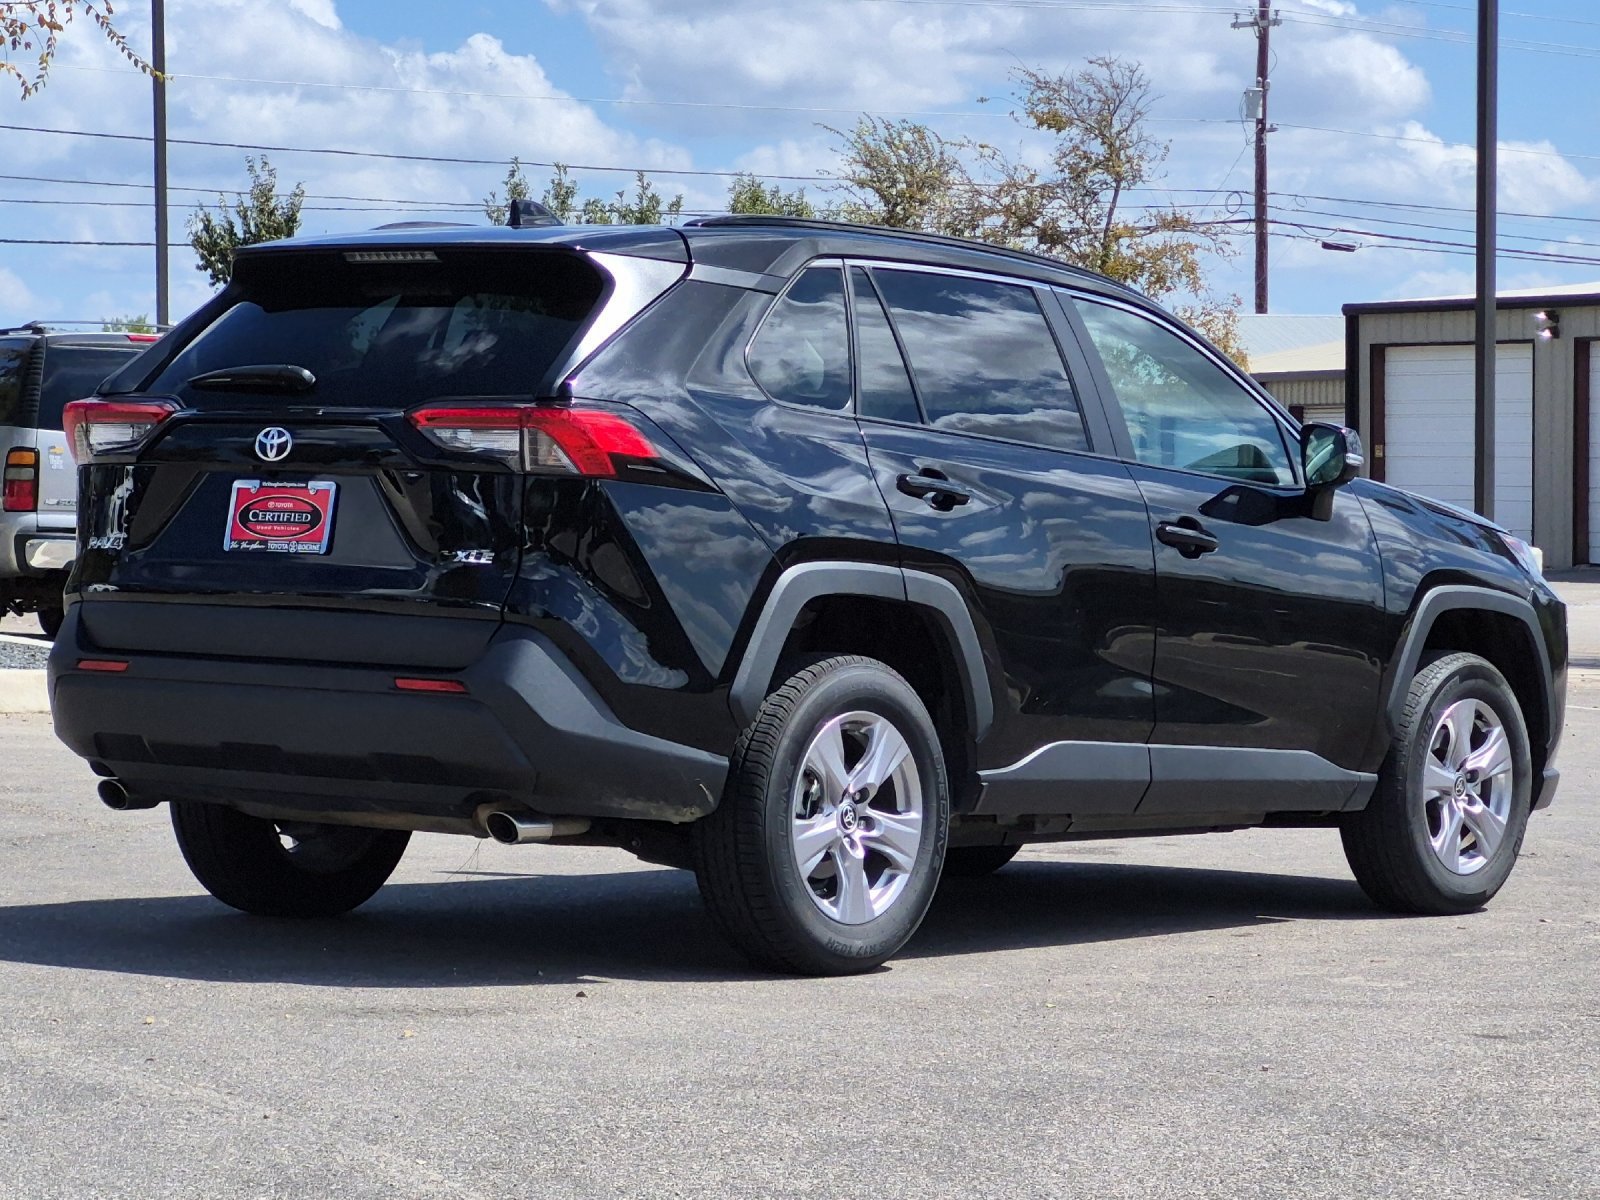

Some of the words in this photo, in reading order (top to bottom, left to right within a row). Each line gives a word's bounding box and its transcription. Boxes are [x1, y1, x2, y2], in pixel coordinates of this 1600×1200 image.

[249, 509, 311, 522] CERTIFIED
[88, 535, 124, 550] RAV4
[453, 550, 495, 564] XLE
